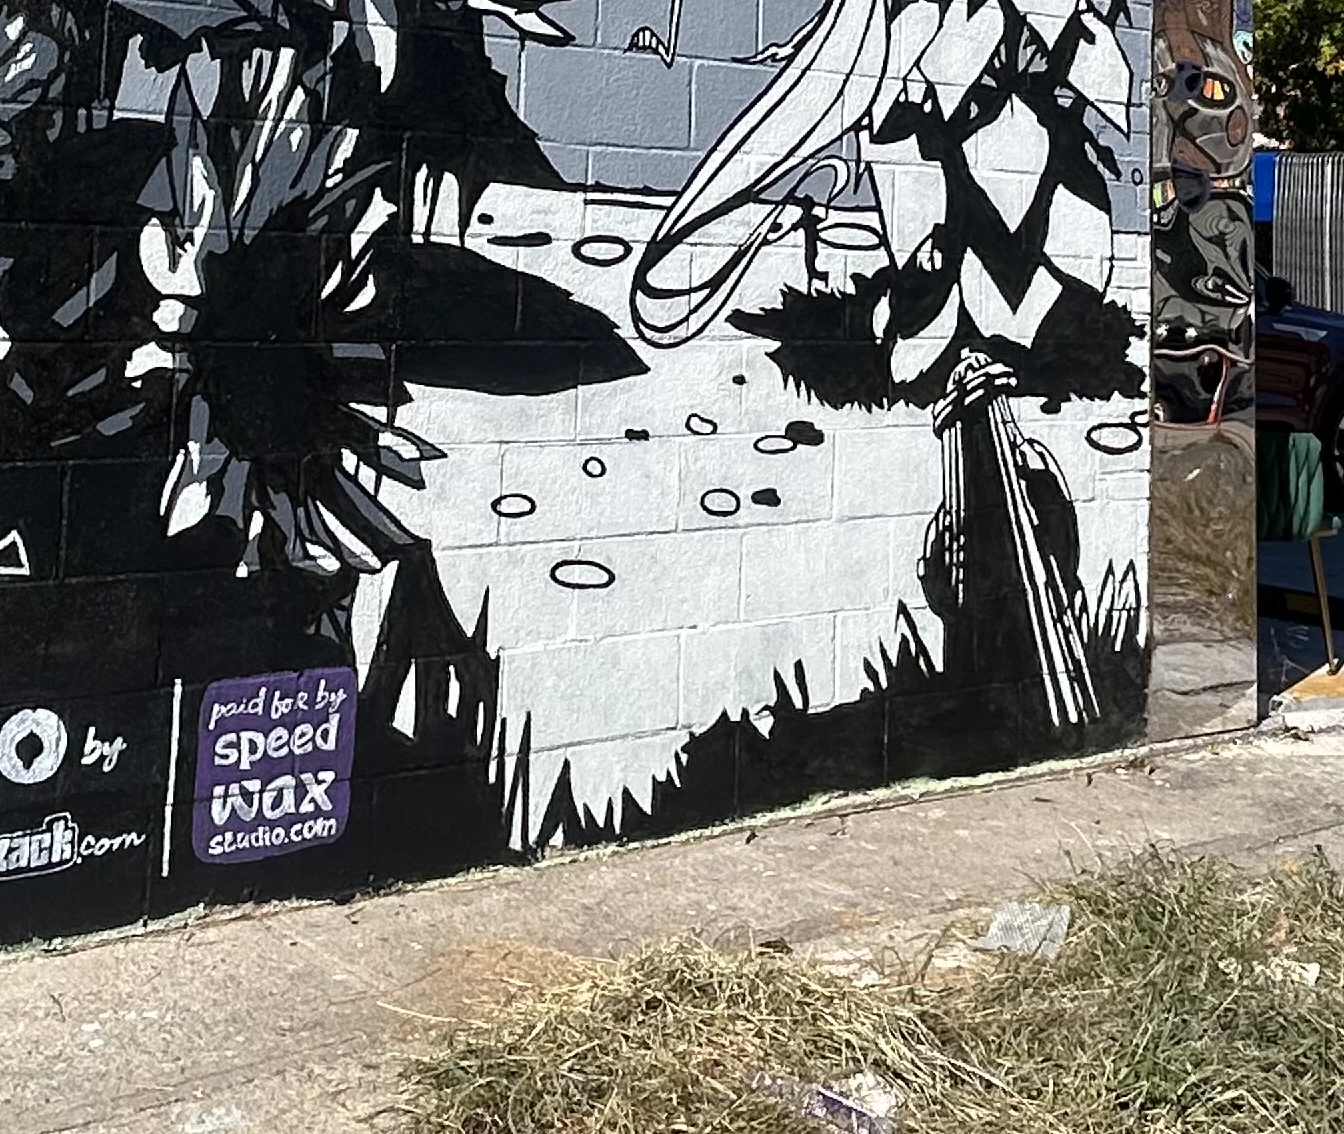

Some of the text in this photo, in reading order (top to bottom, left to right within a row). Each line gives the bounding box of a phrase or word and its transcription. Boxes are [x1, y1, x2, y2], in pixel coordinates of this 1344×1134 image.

[208, 686, 267, 731] paid
[314, 678, 348, 714] by
[80, 726, 128, 773] by
[213, 712, 341, 771] speed
[210, 770, 337, 827] wax
[208, 816, 338, 856] studio.com
